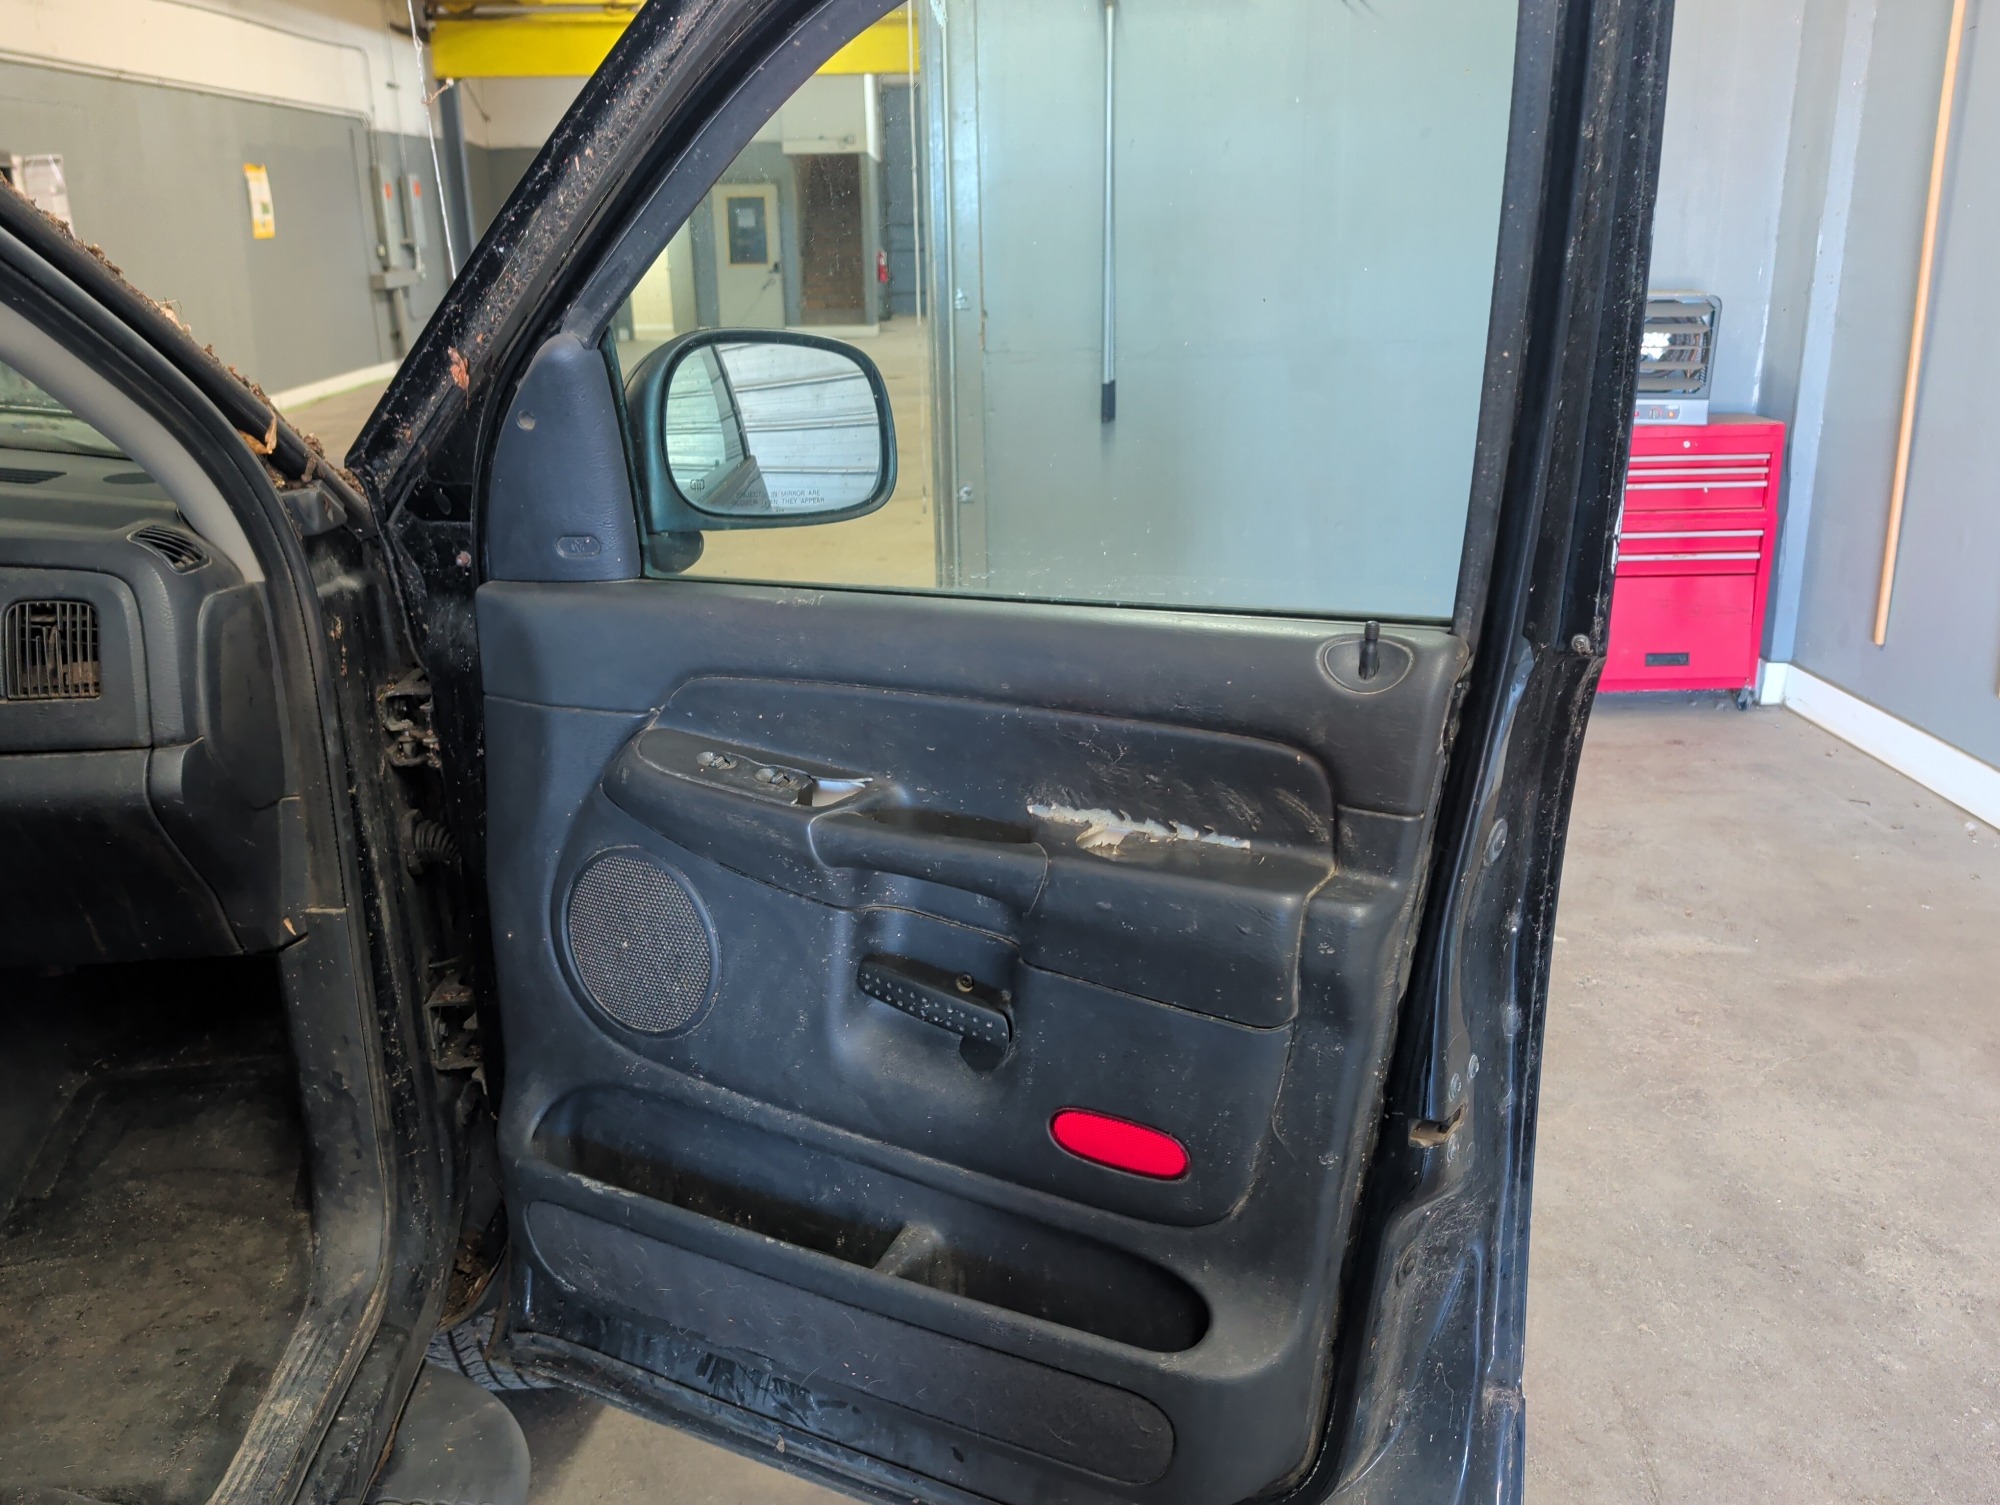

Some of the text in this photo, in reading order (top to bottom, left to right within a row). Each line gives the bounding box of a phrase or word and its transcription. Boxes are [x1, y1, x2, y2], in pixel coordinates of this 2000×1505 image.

[781, 489, 806, 497] MIRROR
[808, 488, 821, 496] ARE
[800, 497, 825, 505] APPEAR
